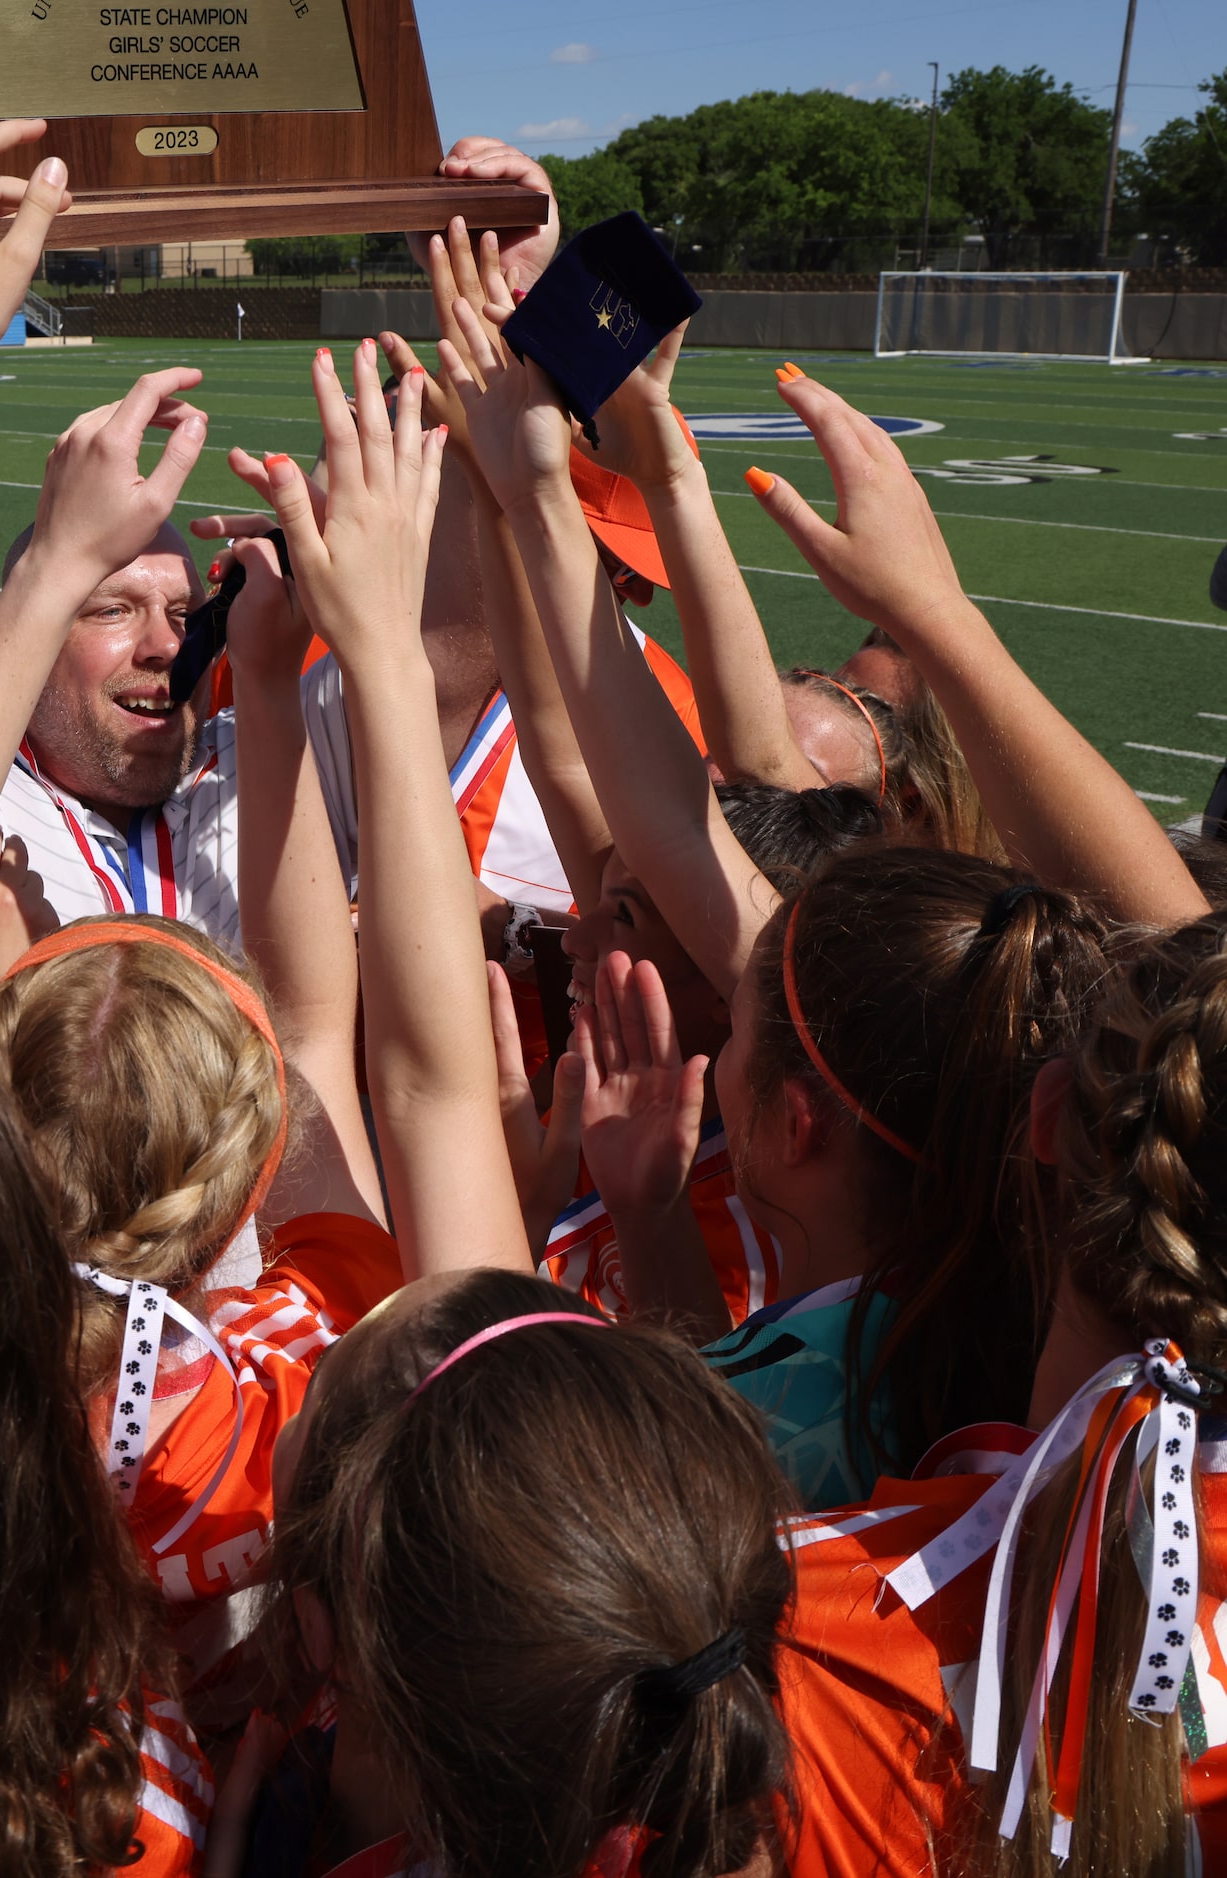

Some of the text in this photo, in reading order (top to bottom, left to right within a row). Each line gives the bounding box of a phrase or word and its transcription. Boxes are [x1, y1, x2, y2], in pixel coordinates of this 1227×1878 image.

[99, 7, 249, 27] STATE CHAMPION
[169, 35, 241, 53] SOCCER
[90, 62, 260, 82] CONFERENCE AAAA
[153, 129, 200, 151] 2023
